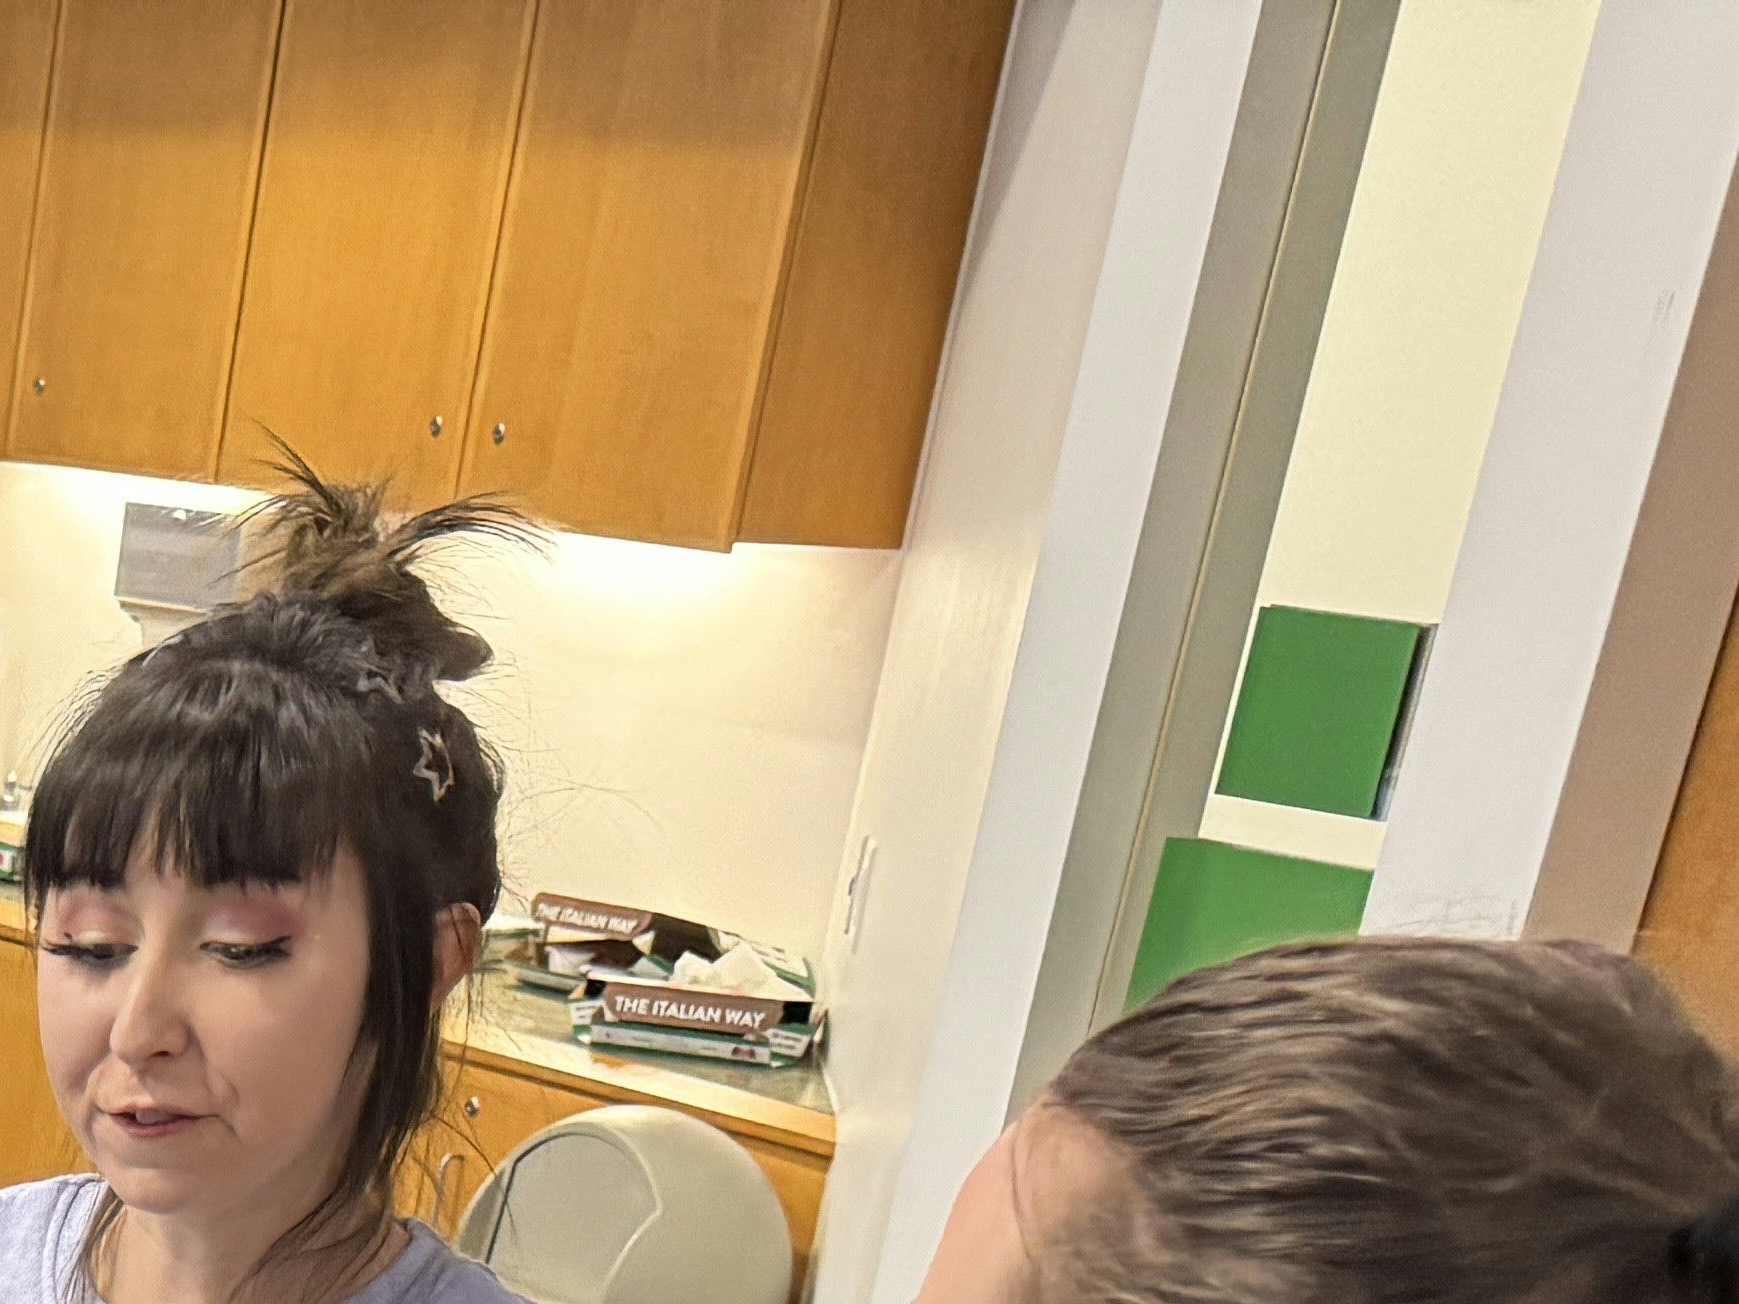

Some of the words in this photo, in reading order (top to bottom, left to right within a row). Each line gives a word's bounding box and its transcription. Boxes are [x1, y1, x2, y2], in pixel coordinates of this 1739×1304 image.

[614, 995, 652, 1015] THE
[652, 1000, 721, 1023] ITALIAN
[725, 1010, 766, 1028] WAY
